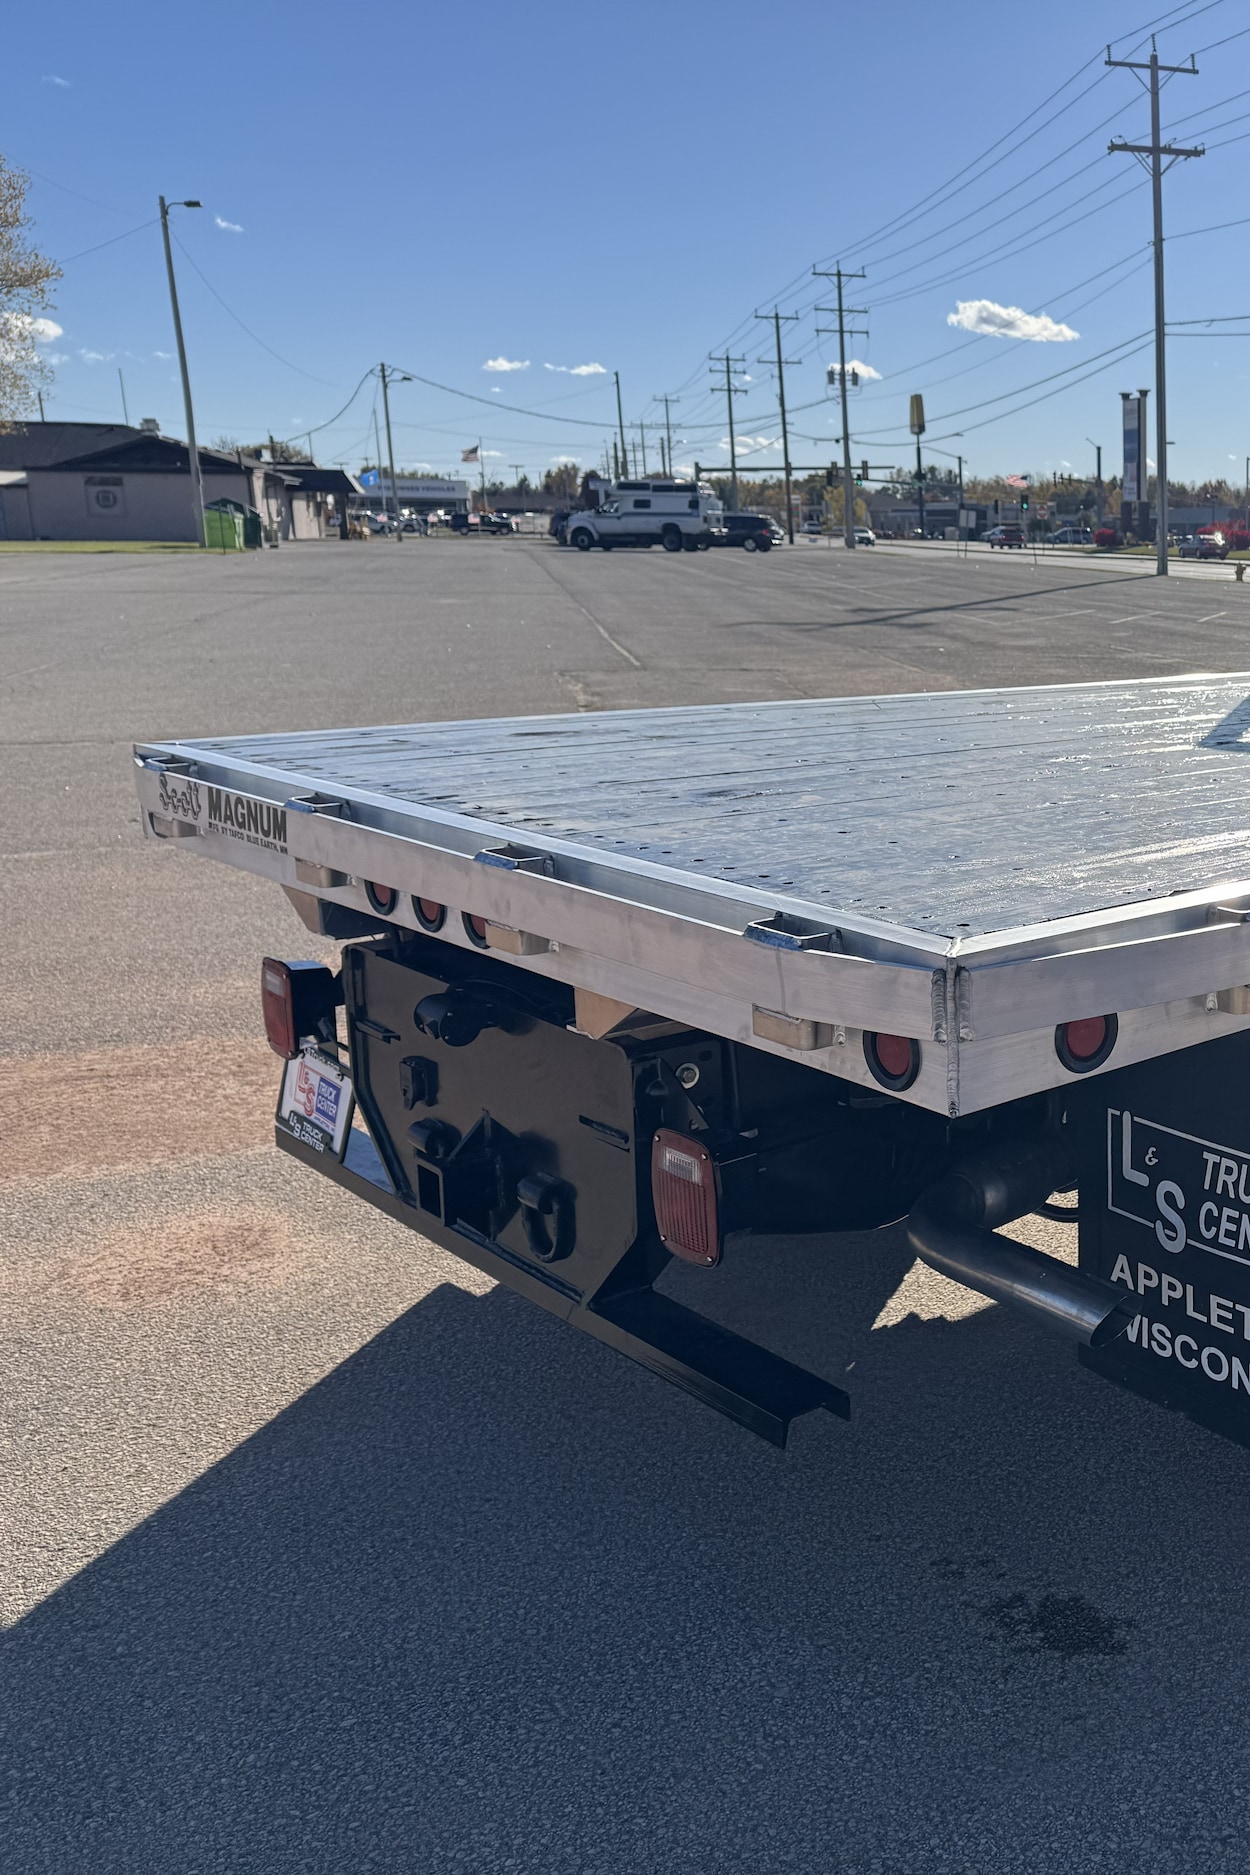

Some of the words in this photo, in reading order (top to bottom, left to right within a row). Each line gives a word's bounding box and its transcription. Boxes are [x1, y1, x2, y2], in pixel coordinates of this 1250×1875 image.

[159, 773, 201, 821] Scott
[207, 786, 287, 843] MAGNUM
[319, 1081, 337, 1102] TRUCK
[317, 1095, 337, 1118] CENTER
[301, 1130, 325, 1153] CENTER
[303, 1121, 323, 1141] TRUCK
